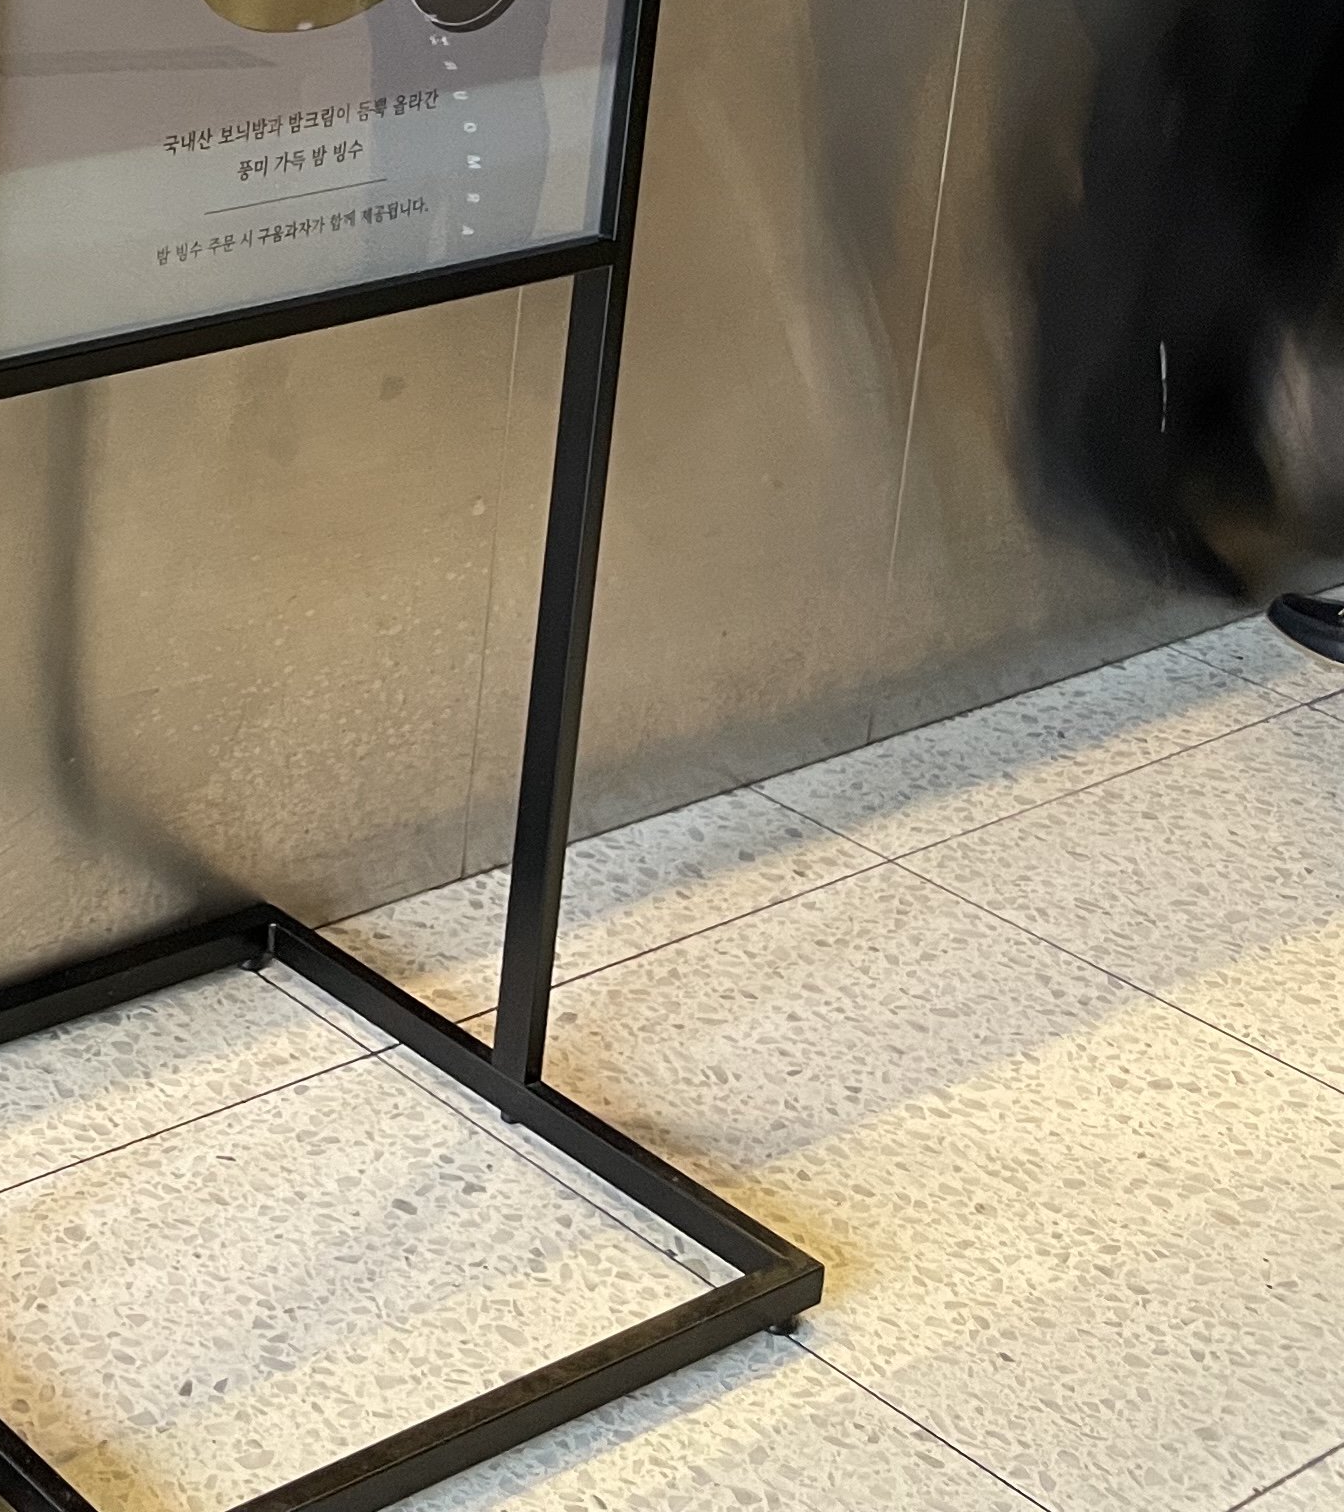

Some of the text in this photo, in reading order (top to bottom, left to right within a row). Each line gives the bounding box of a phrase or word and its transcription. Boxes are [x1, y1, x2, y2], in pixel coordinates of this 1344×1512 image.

[163, 127, 213, 155] 국내산
[218, 115, 283, 145] 보늬밤과
[289, 103, 350, 134] 밤크림이
[393, 88, 439, 116] 올라간
[237, 139, 363, 181] 풍미 가득 밤 빙수
[156, 245, 170, 265] 밤
[176, 241, 203, 262] 빙수
[208, 234, 235, 255] 주문
[240, 230, 253, 248] 시
